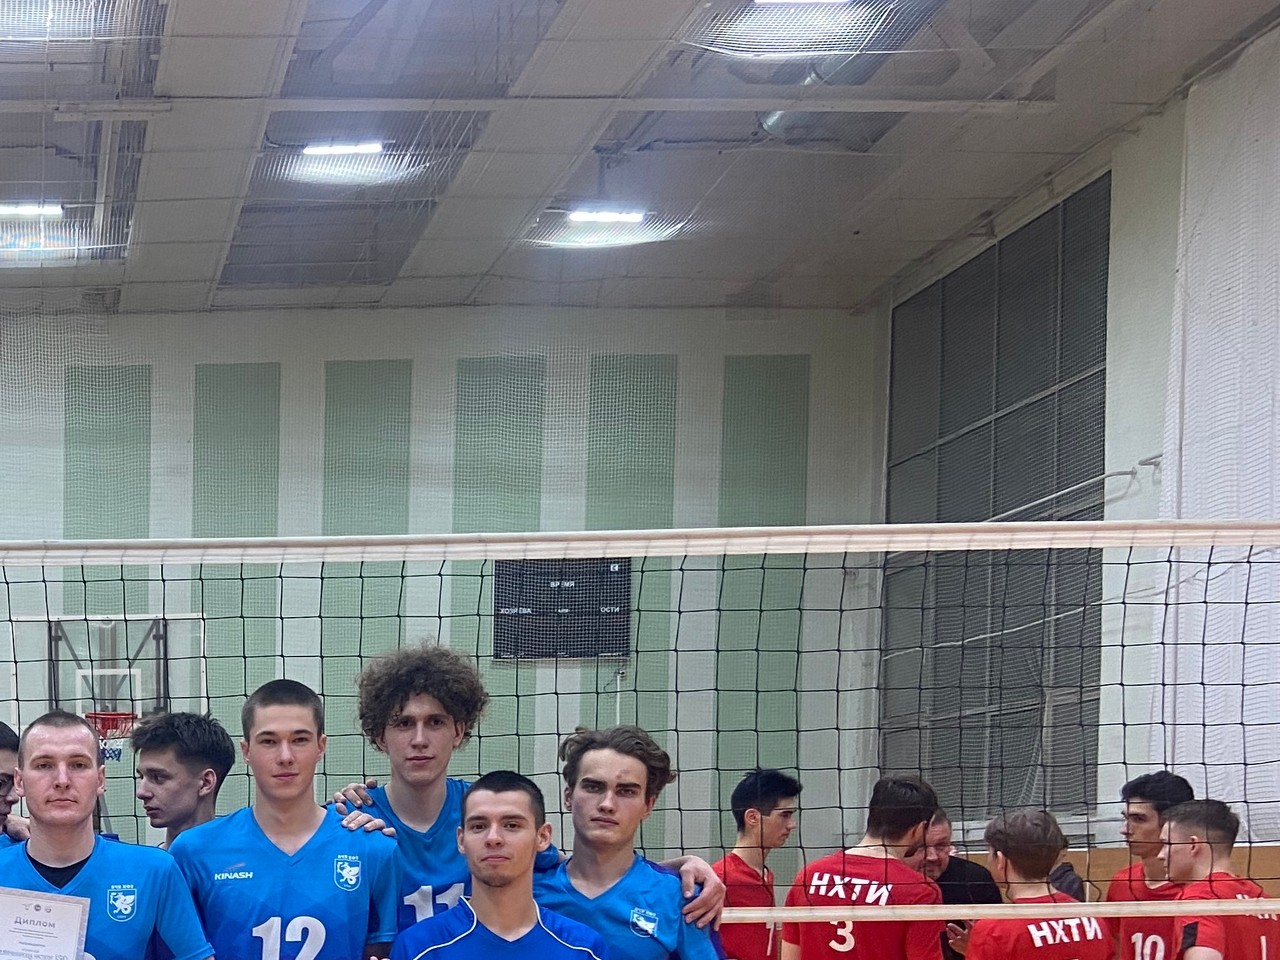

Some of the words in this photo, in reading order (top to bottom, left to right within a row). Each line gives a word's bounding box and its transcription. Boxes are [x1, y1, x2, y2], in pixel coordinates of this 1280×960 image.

[214, 871, 254, 881] KINASH
[808, 871, 893, 906] НХТИ
[14, 915, 56, 929] Диплом
[1027, 916, 1103, 948] НХТИ
